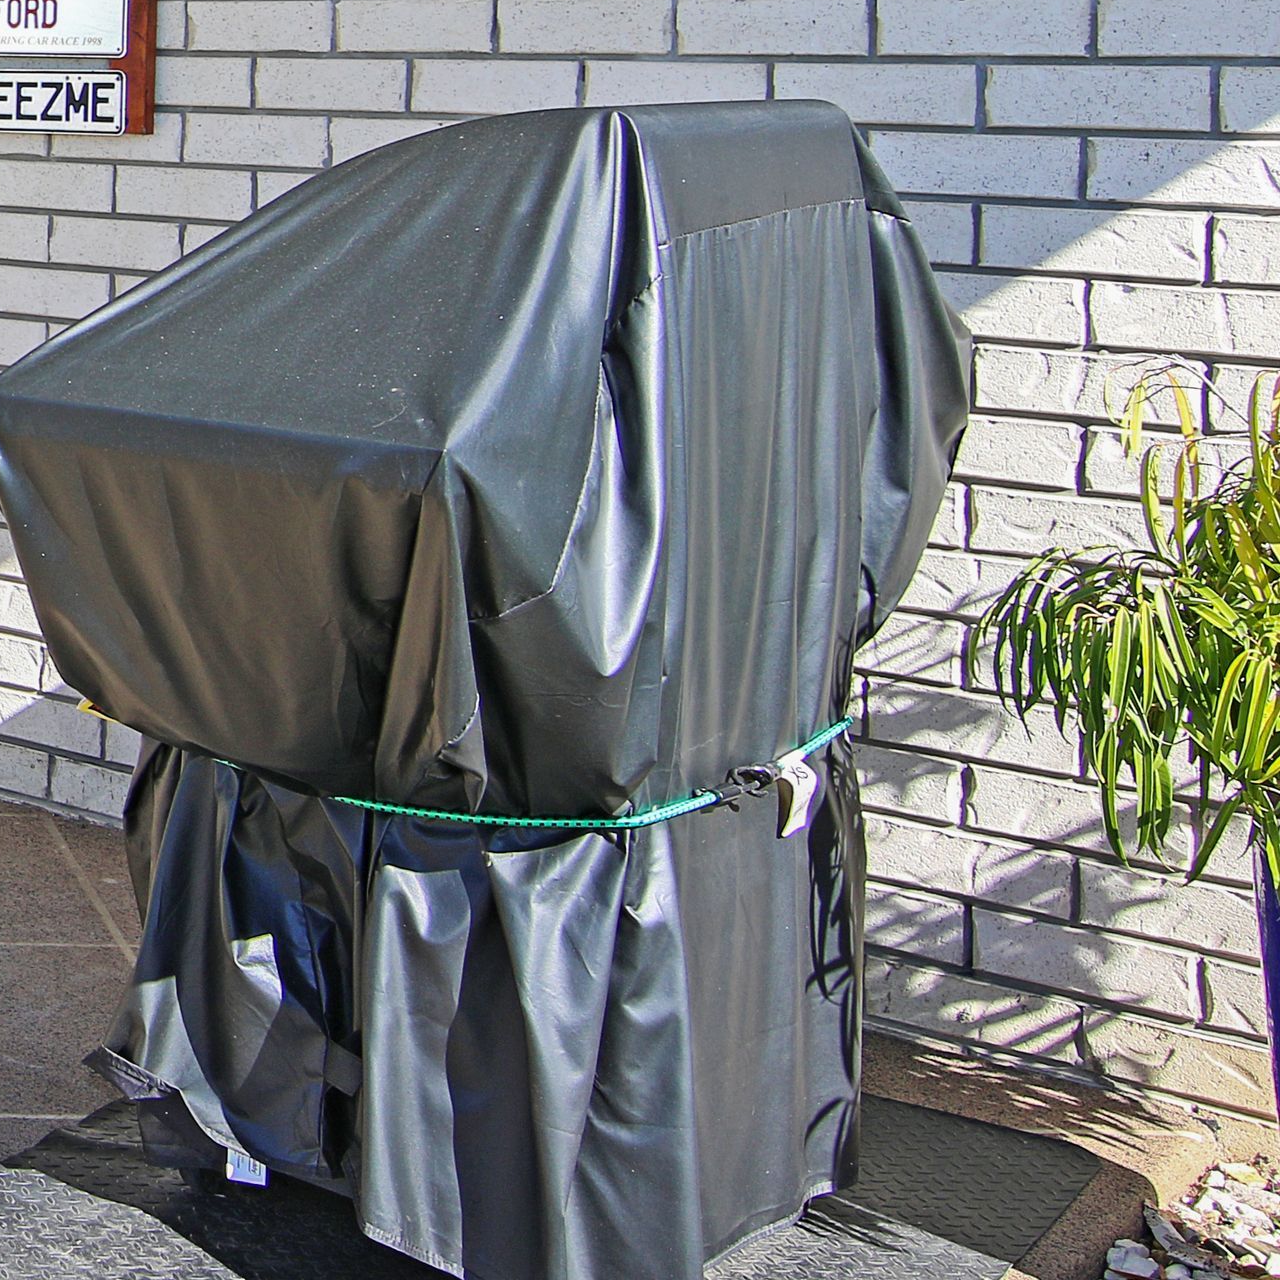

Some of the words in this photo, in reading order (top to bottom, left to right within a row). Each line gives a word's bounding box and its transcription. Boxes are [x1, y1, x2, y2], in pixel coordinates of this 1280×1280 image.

[27, 35, 51, 46] CAR
[51, 35, 80, 46] RACE
[82, 36, 103, 46] 1998
